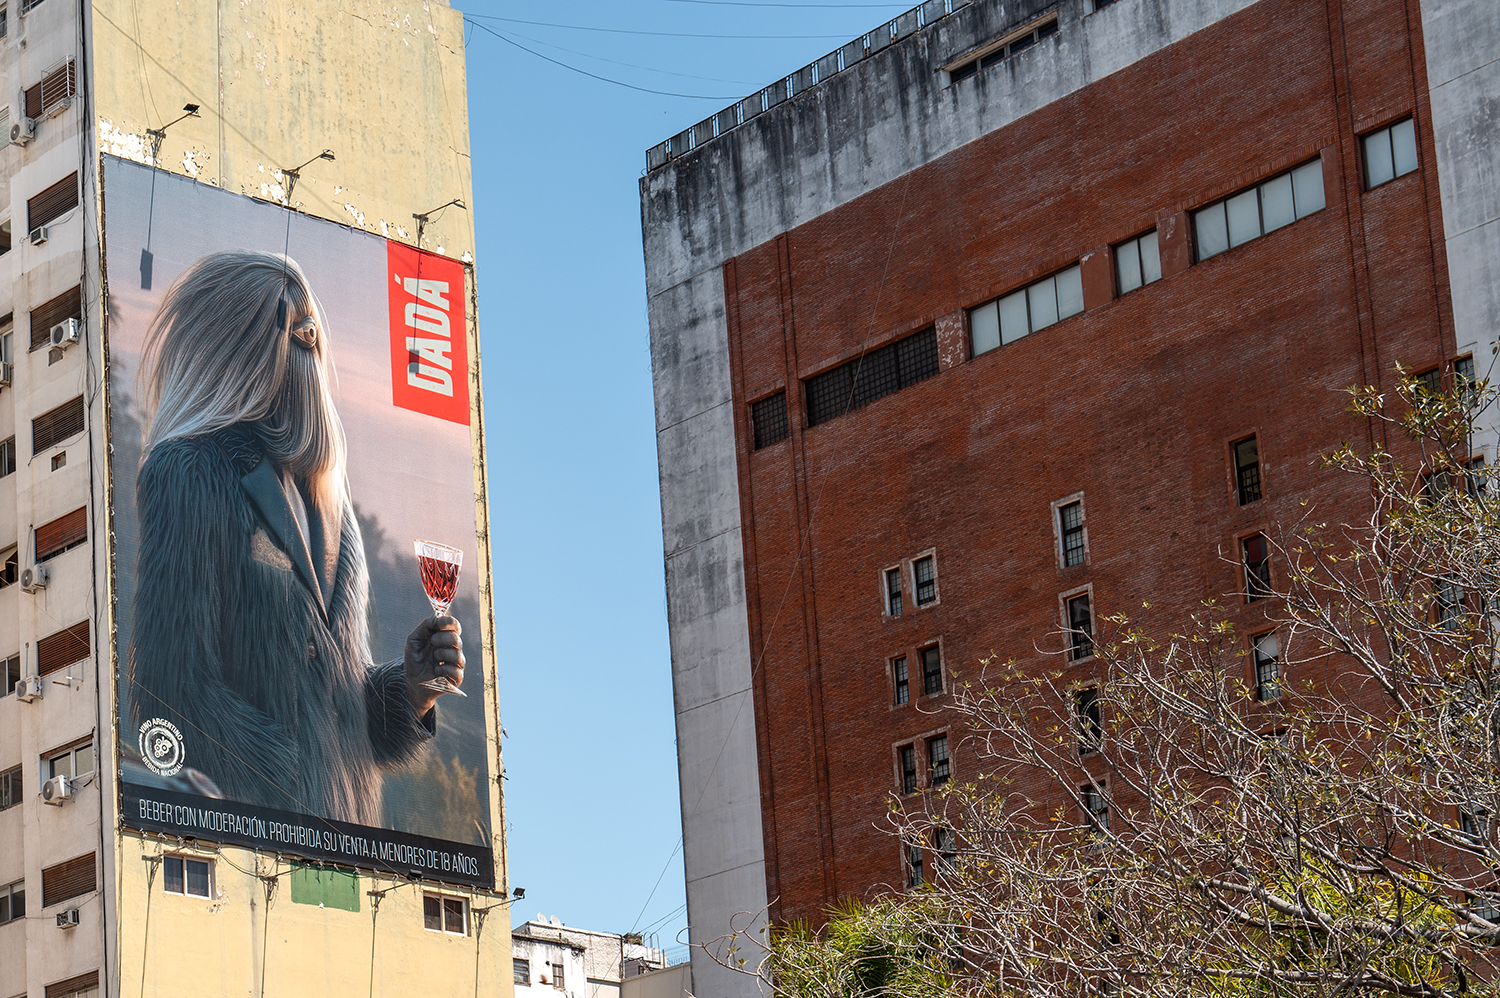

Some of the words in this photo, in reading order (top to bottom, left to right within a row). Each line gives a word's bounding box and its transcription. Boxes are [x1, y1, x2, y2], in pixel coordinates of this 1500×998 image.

[393, 273, 454, 397] DADÁ
[139, 798, 173, 824] BEBER
[175, 805, 197, 827] CON
[198, 809, 269, 839] MODERACIÓN.
[269, 821, 323, 849] PROHIBIDA
[323, 831, 338, 852] SU
[338, 834, 370, 858] VENTA
[371, 840, 378, 859] A
[379, 840, 425, 868] MENORES
[426, 849, 439, 870] DE
[439, 851, 450, 871] 18
[451, 852, 480, 877] AÑOS.
